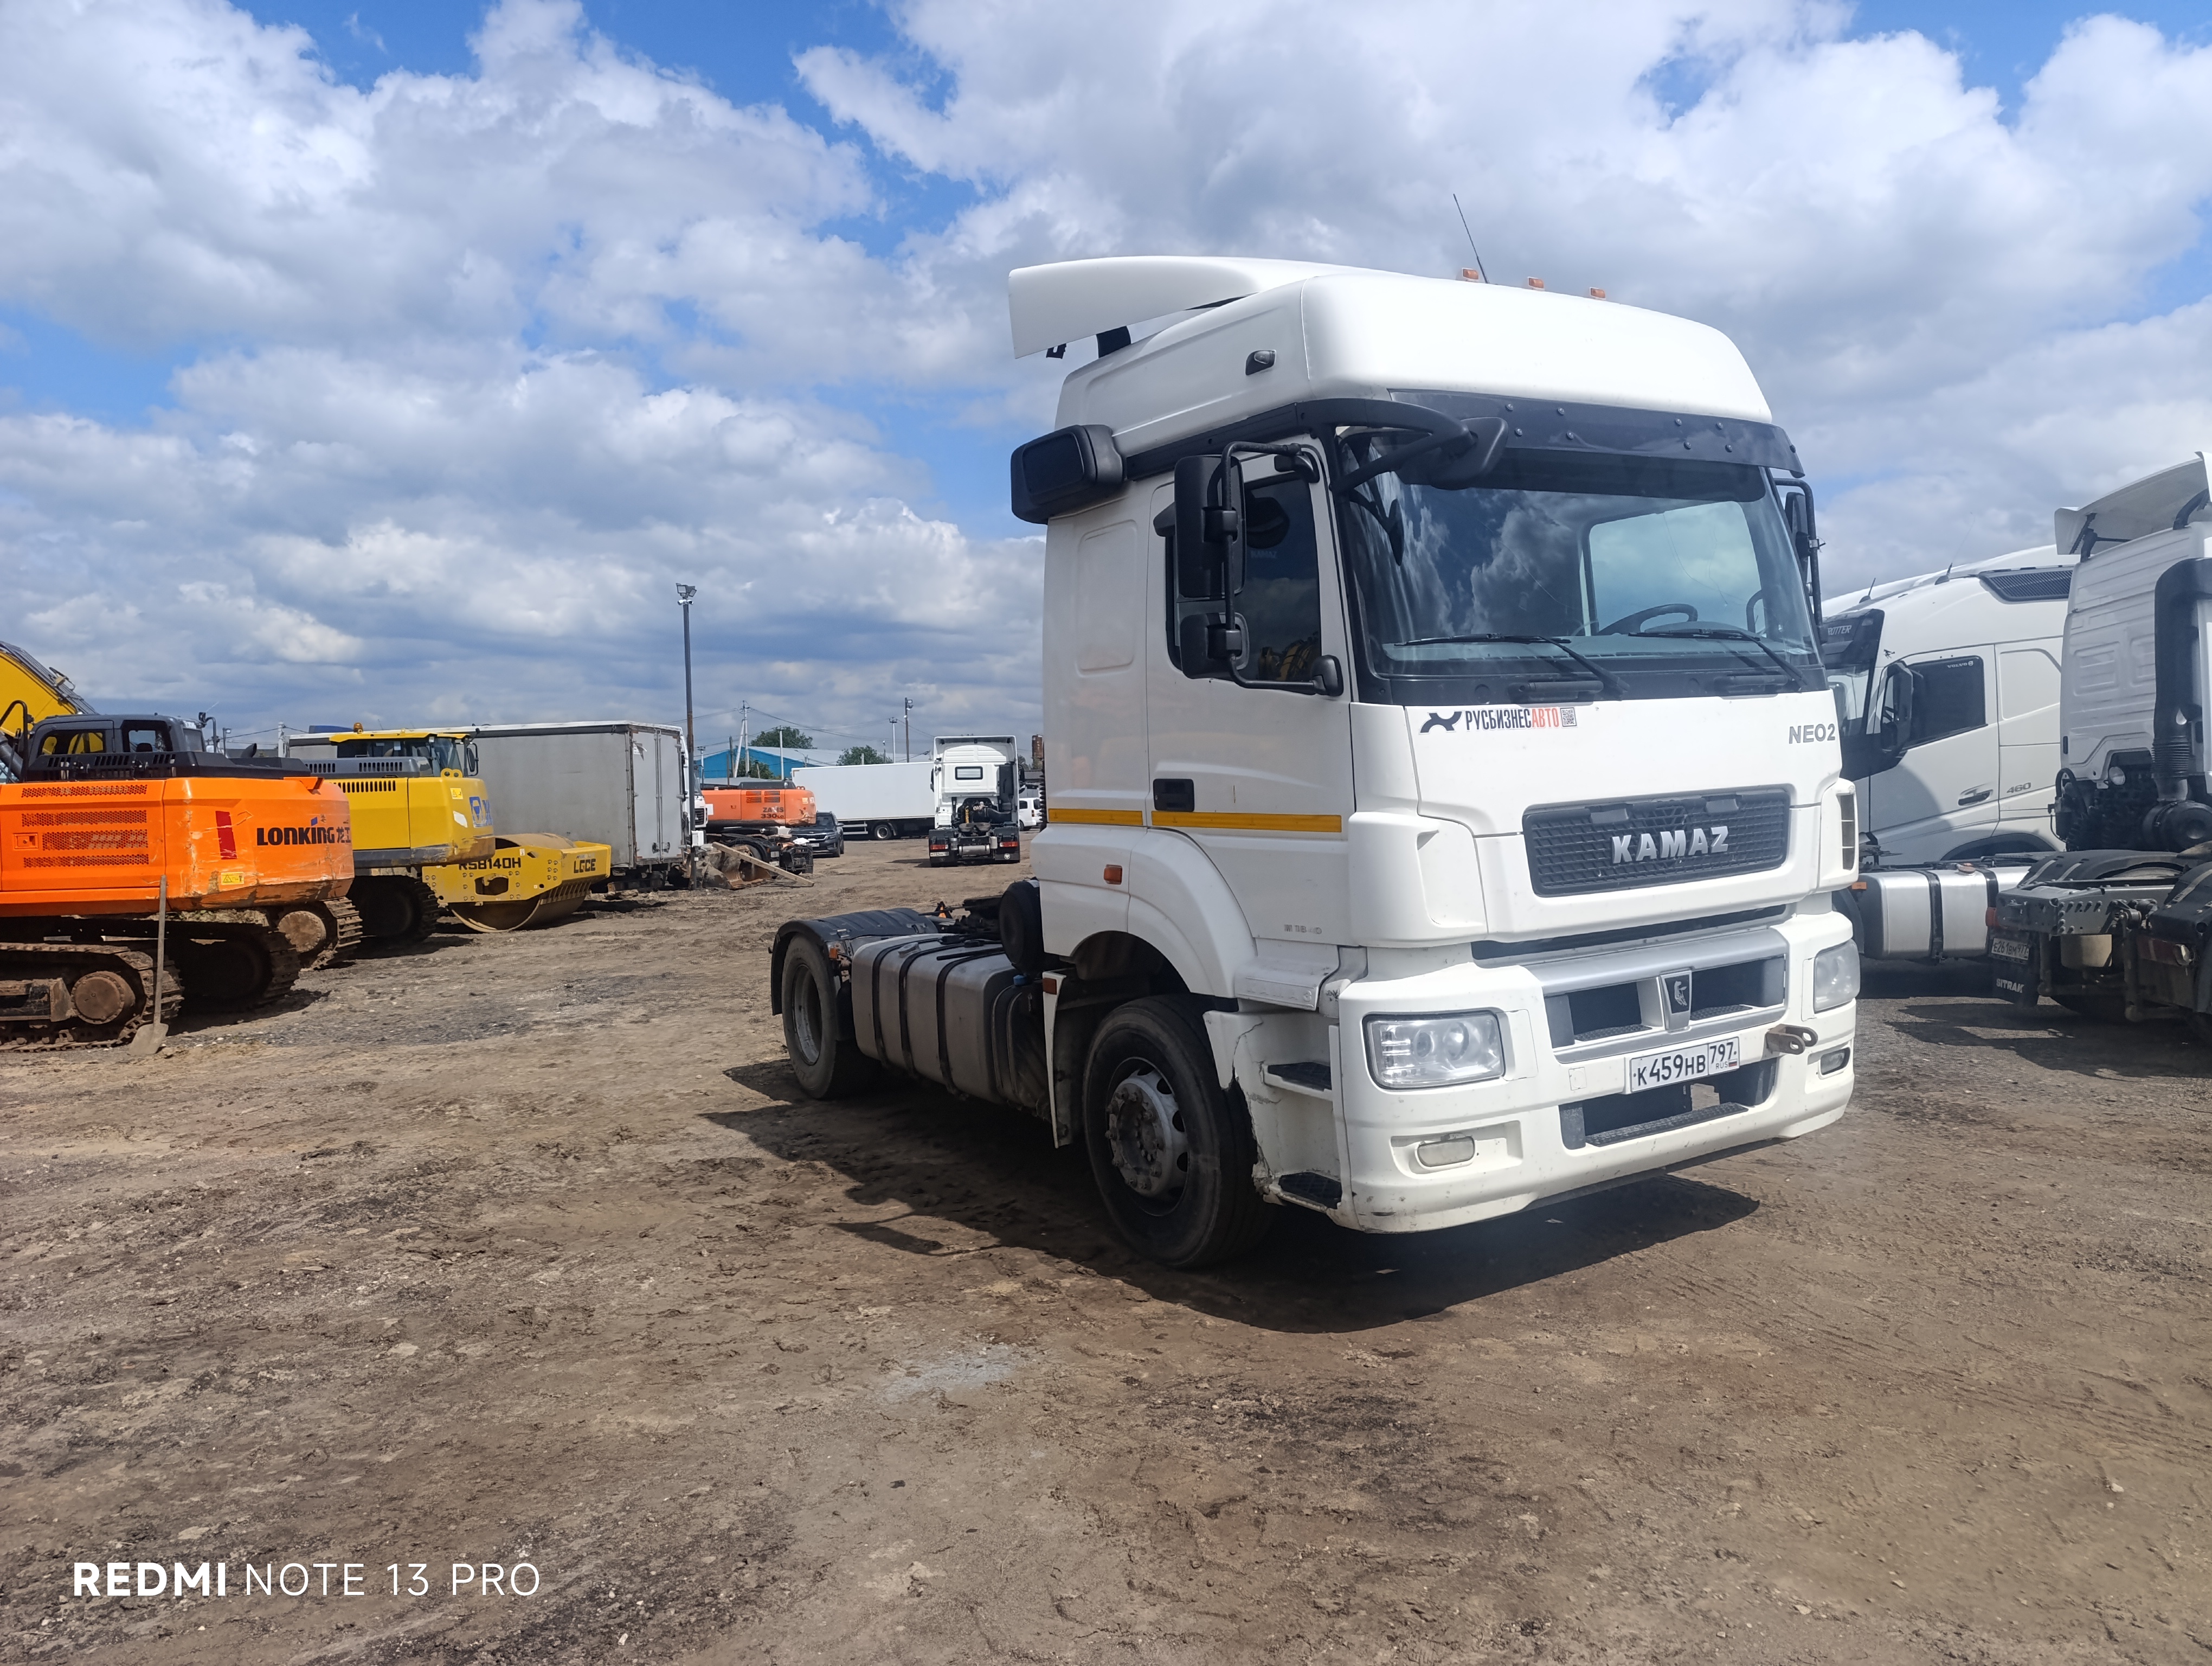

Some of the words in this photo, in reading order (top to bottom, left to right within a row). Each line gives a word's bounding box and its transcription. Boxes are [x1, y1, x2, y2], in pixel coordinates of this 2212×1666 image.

[1789, 723, 1835, 744] NEO2
[2007, 783, 2031, 793] 460
[256, 818, 335, 846] LONKING
[1612, 826, 1729, 864] KAMAZ
[1996, 978, 2024, 994] SITRAK
[1638, 1054, 1706, 1086] К459НВ
[1709, 1041, 1734, 1065] 797
[1715, 1061, 1728, 1070] RUS
